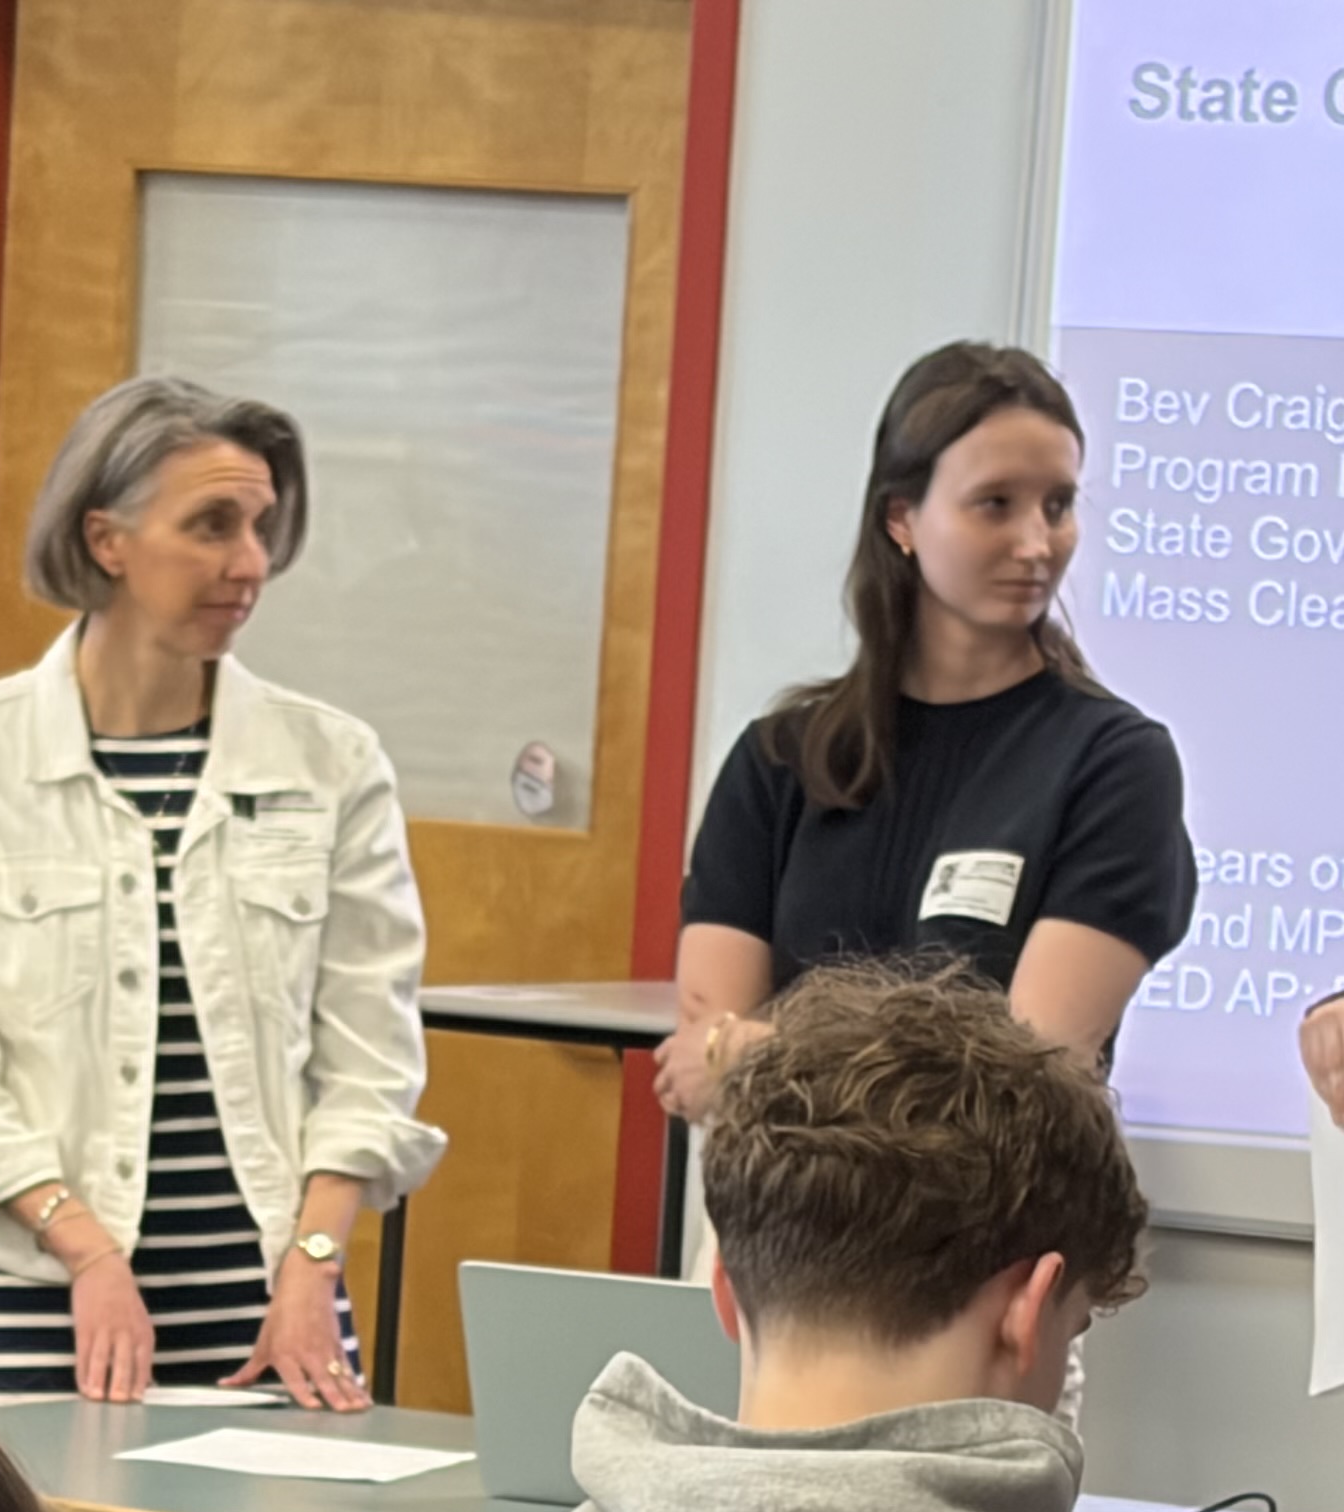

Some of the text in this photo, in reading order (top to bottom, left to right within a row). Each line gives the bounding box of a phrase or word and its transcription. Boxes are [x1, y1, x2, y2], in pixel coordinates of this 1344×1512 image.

[1128, 61, 1298, 124] State
[1116, 377, 1211, 426] Bev
[1110, 442, 1320, 504] Program
[1105, 507, 1233, 559] State
[1101, 570, 1231, 623] Mass
[1195, 847, 1295, 889] ears
[1192, 902, 1253, 951] nd
[1140, 963, 1213, 1011] ED
